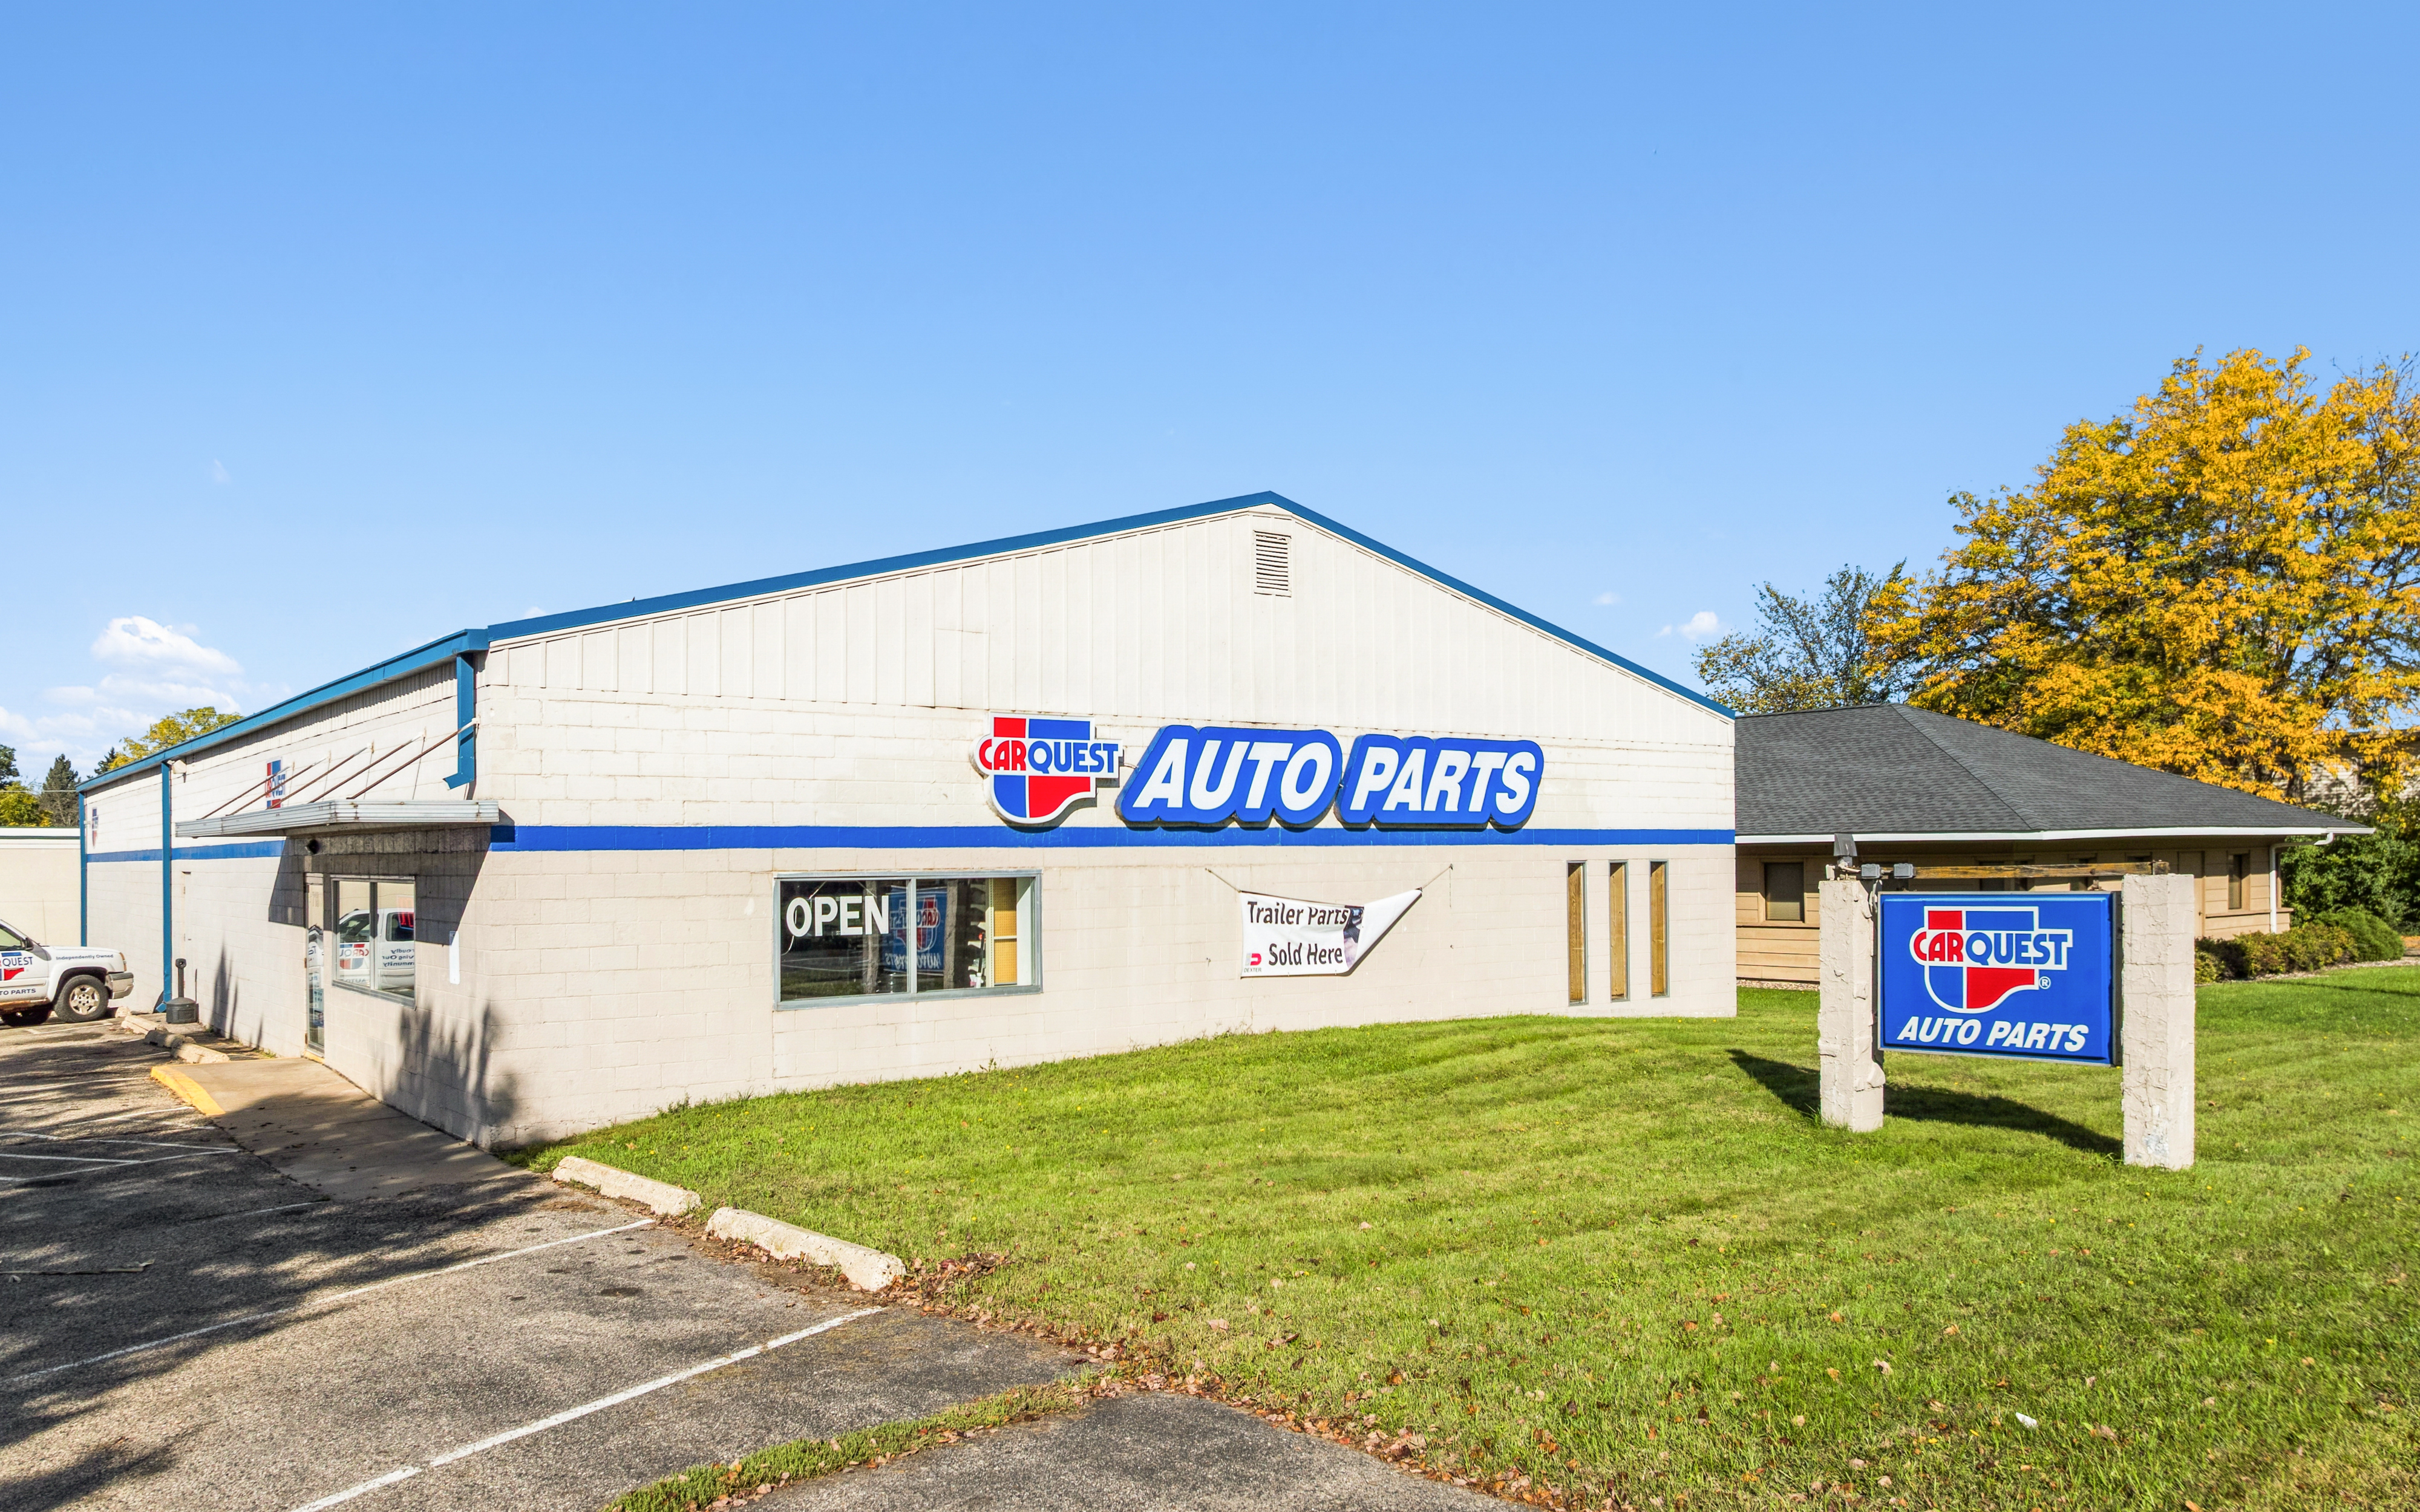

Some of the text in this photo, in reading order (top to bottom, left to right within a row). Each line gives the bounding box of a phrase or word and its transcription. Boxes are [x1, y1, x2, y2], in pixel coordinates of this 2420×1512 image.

[979, 737, 1536, 815] CARQUEST AUTO PARTS
[786, 895, 889, 937] OPEN
[1248, 901, 1349, 925] Trailer Parts
[0, 957, 33, 967] QUEST
[1268, 942, 1343, 966] Sold Here
[1914, 931, 2068, 966] CARQUEST
[1897, 1016, 2089, 1052] AUTO PARTS
